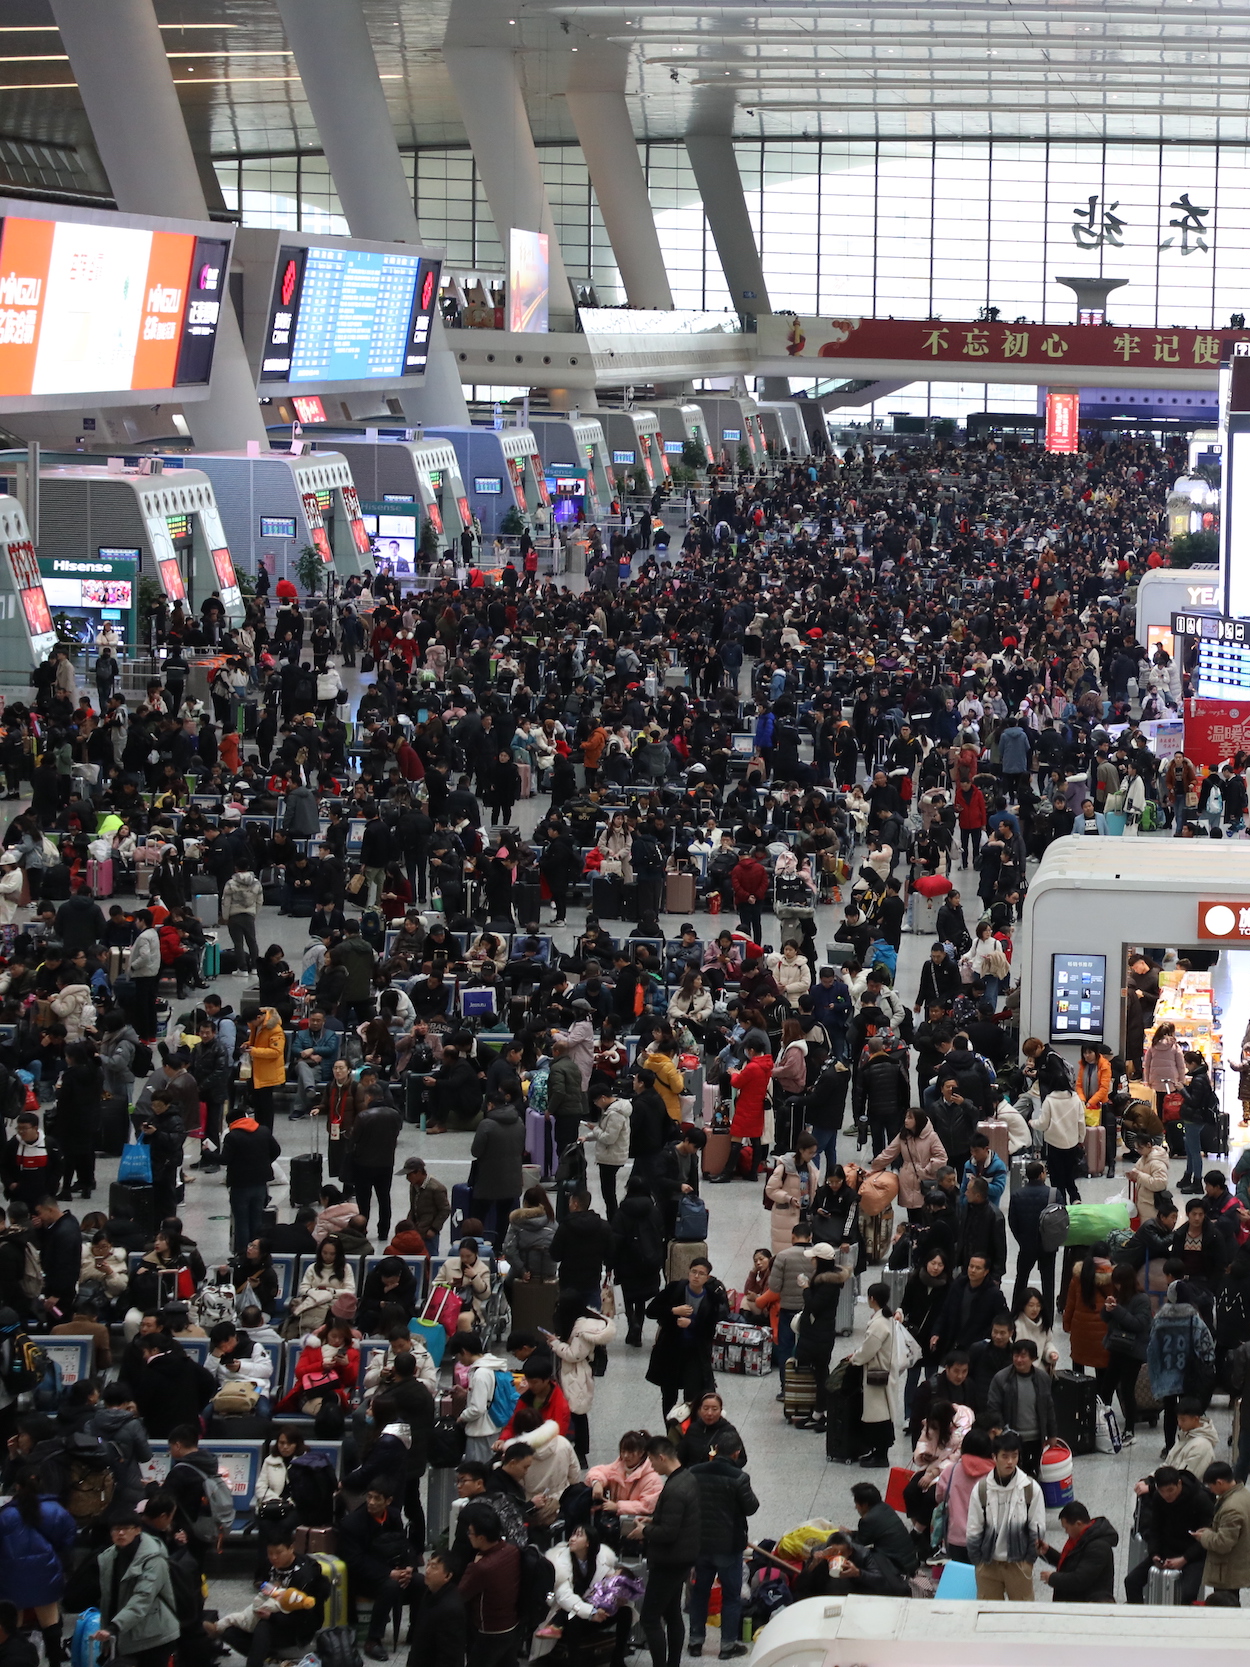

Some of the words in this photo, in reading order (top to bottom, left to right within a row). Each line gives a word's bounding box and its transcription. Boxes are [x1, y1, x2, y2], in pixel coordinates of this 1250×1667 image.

[921, 327, 1068, 358] 不忘初心
[1113, 333, 1224, 364] 牢记使
[53, 560, 113, 572] Hisense
